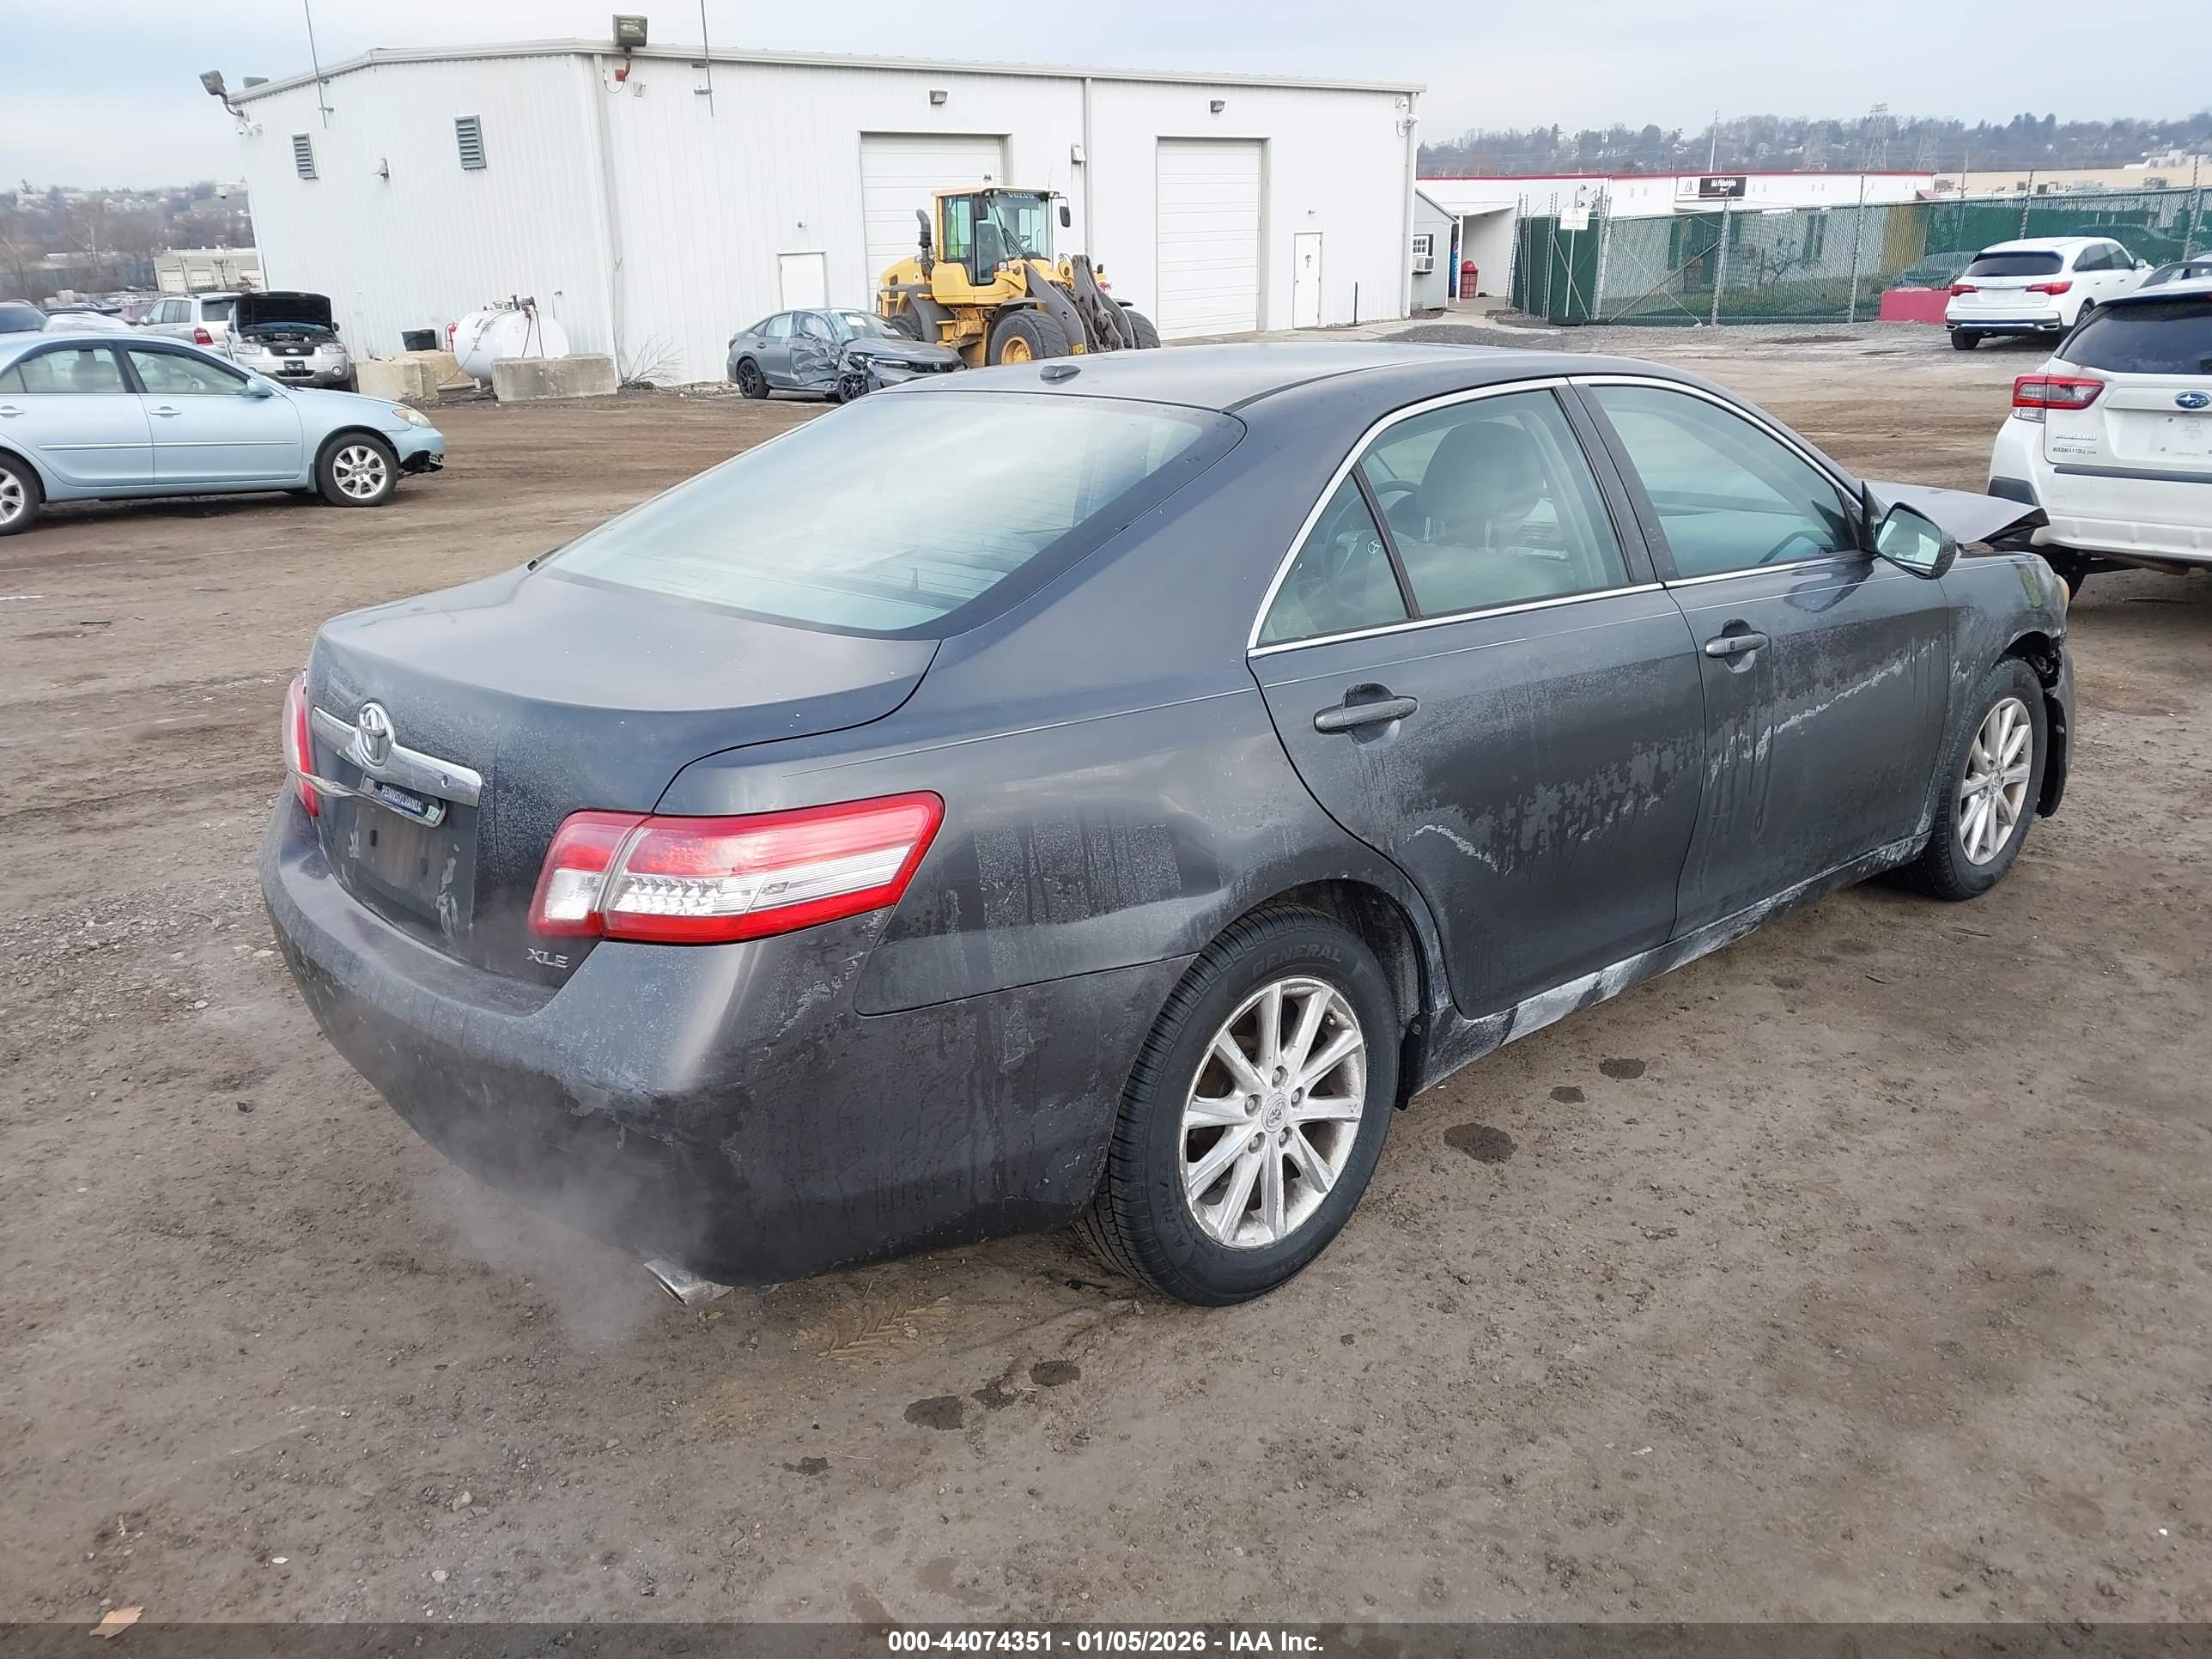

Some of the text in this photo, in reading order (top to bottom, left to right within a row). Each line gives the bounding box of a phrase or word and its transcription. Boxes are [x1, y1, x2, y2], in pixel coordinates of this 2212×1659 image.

[380, 785, 422, 812] PENNSYLVANIA
[526, 947, 570, 969] XLE
[1252, 943, 1342, 977] GENERAL
